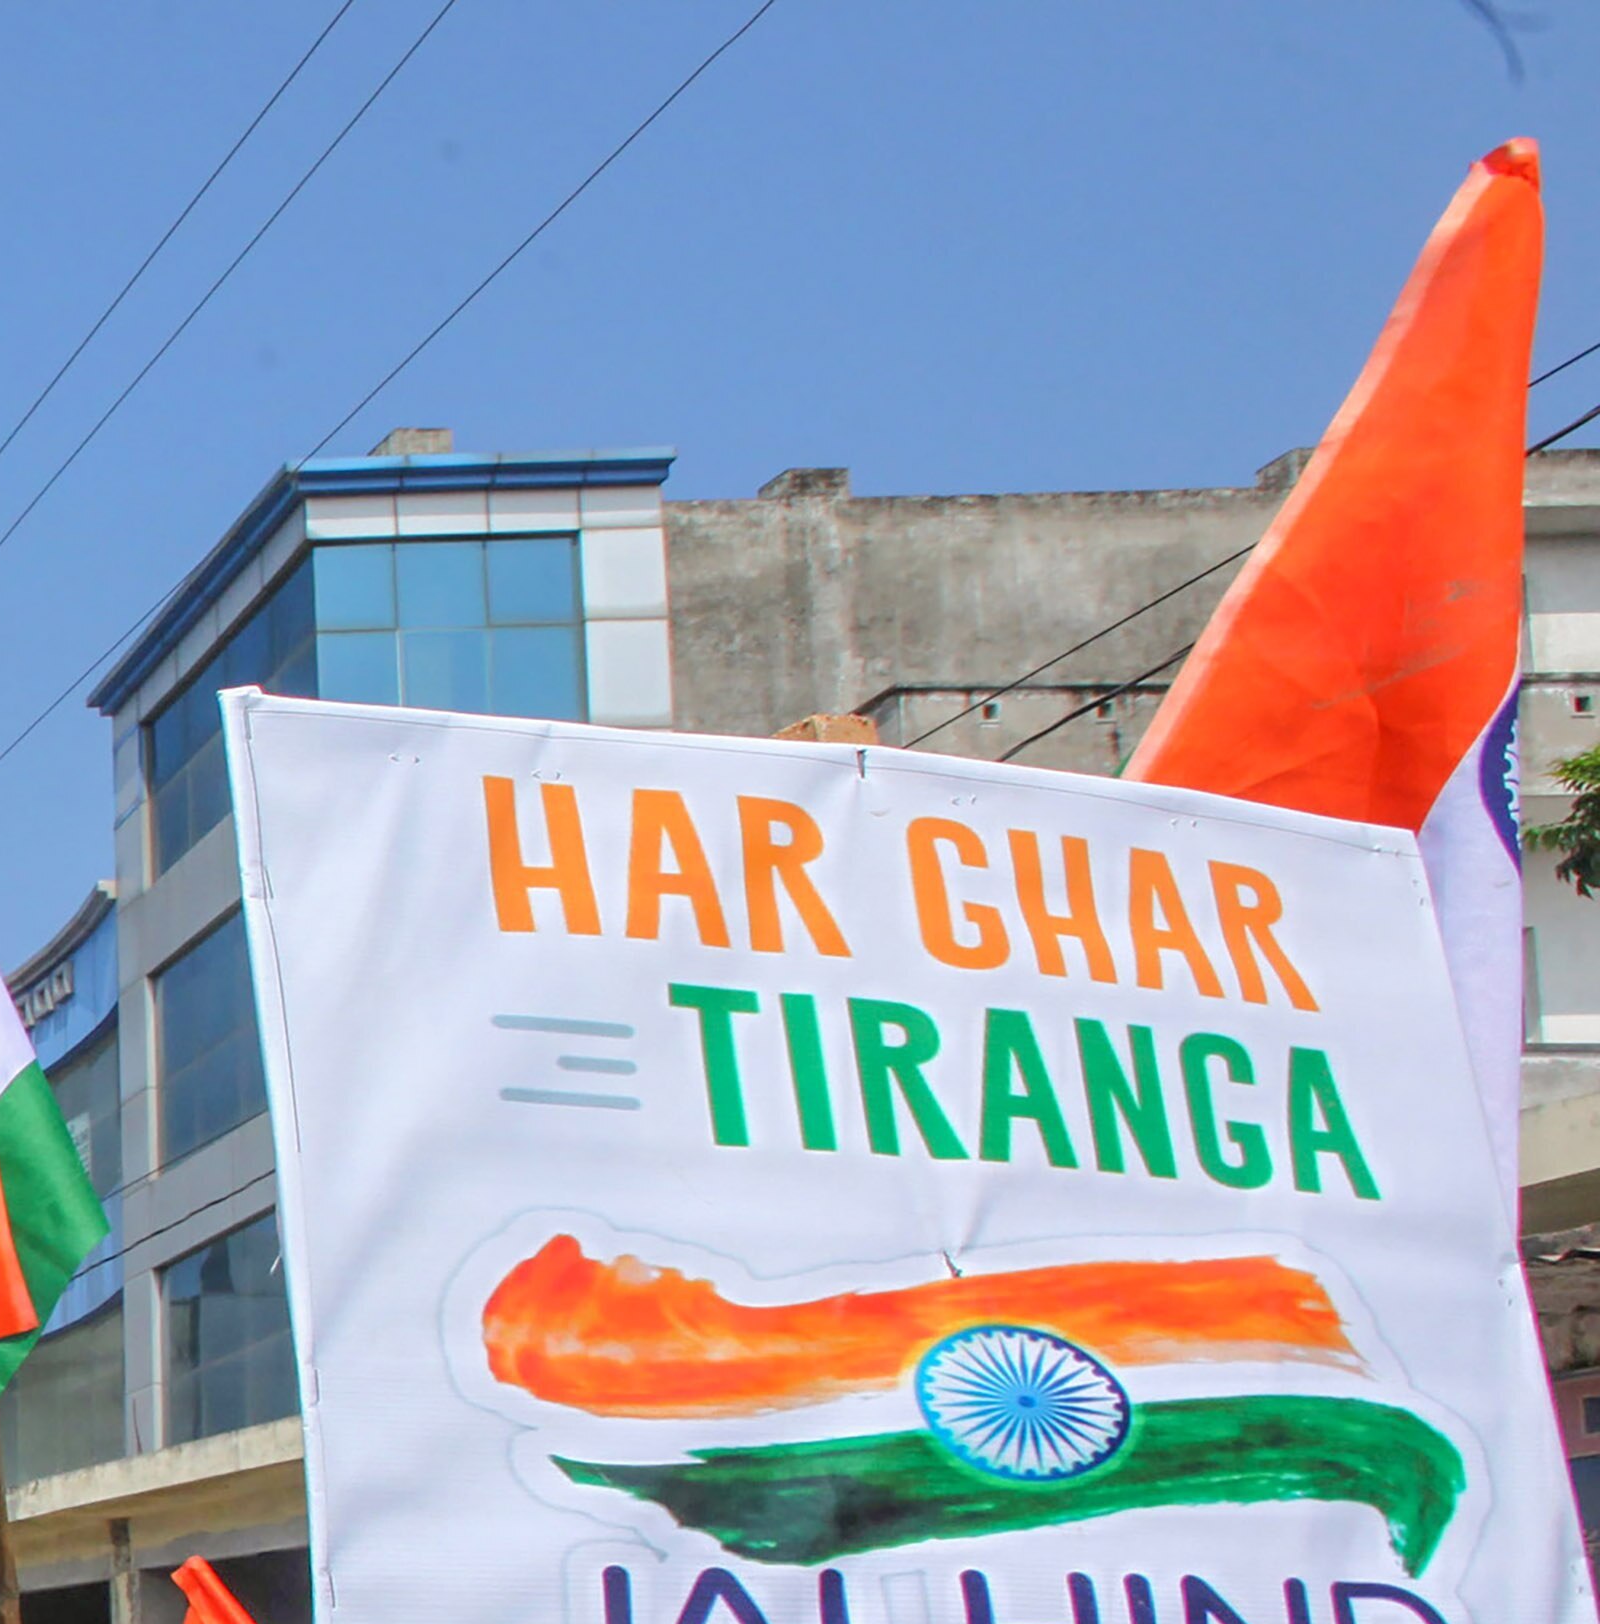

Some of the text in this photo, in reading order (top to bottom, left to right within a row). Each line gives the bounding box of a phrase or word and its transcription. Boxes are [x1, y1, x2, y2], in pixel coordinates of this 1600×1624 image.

[482, 774, 1320, 1013] HAR GHAR
[667, 982, 1381, 1201] TIRANGA
